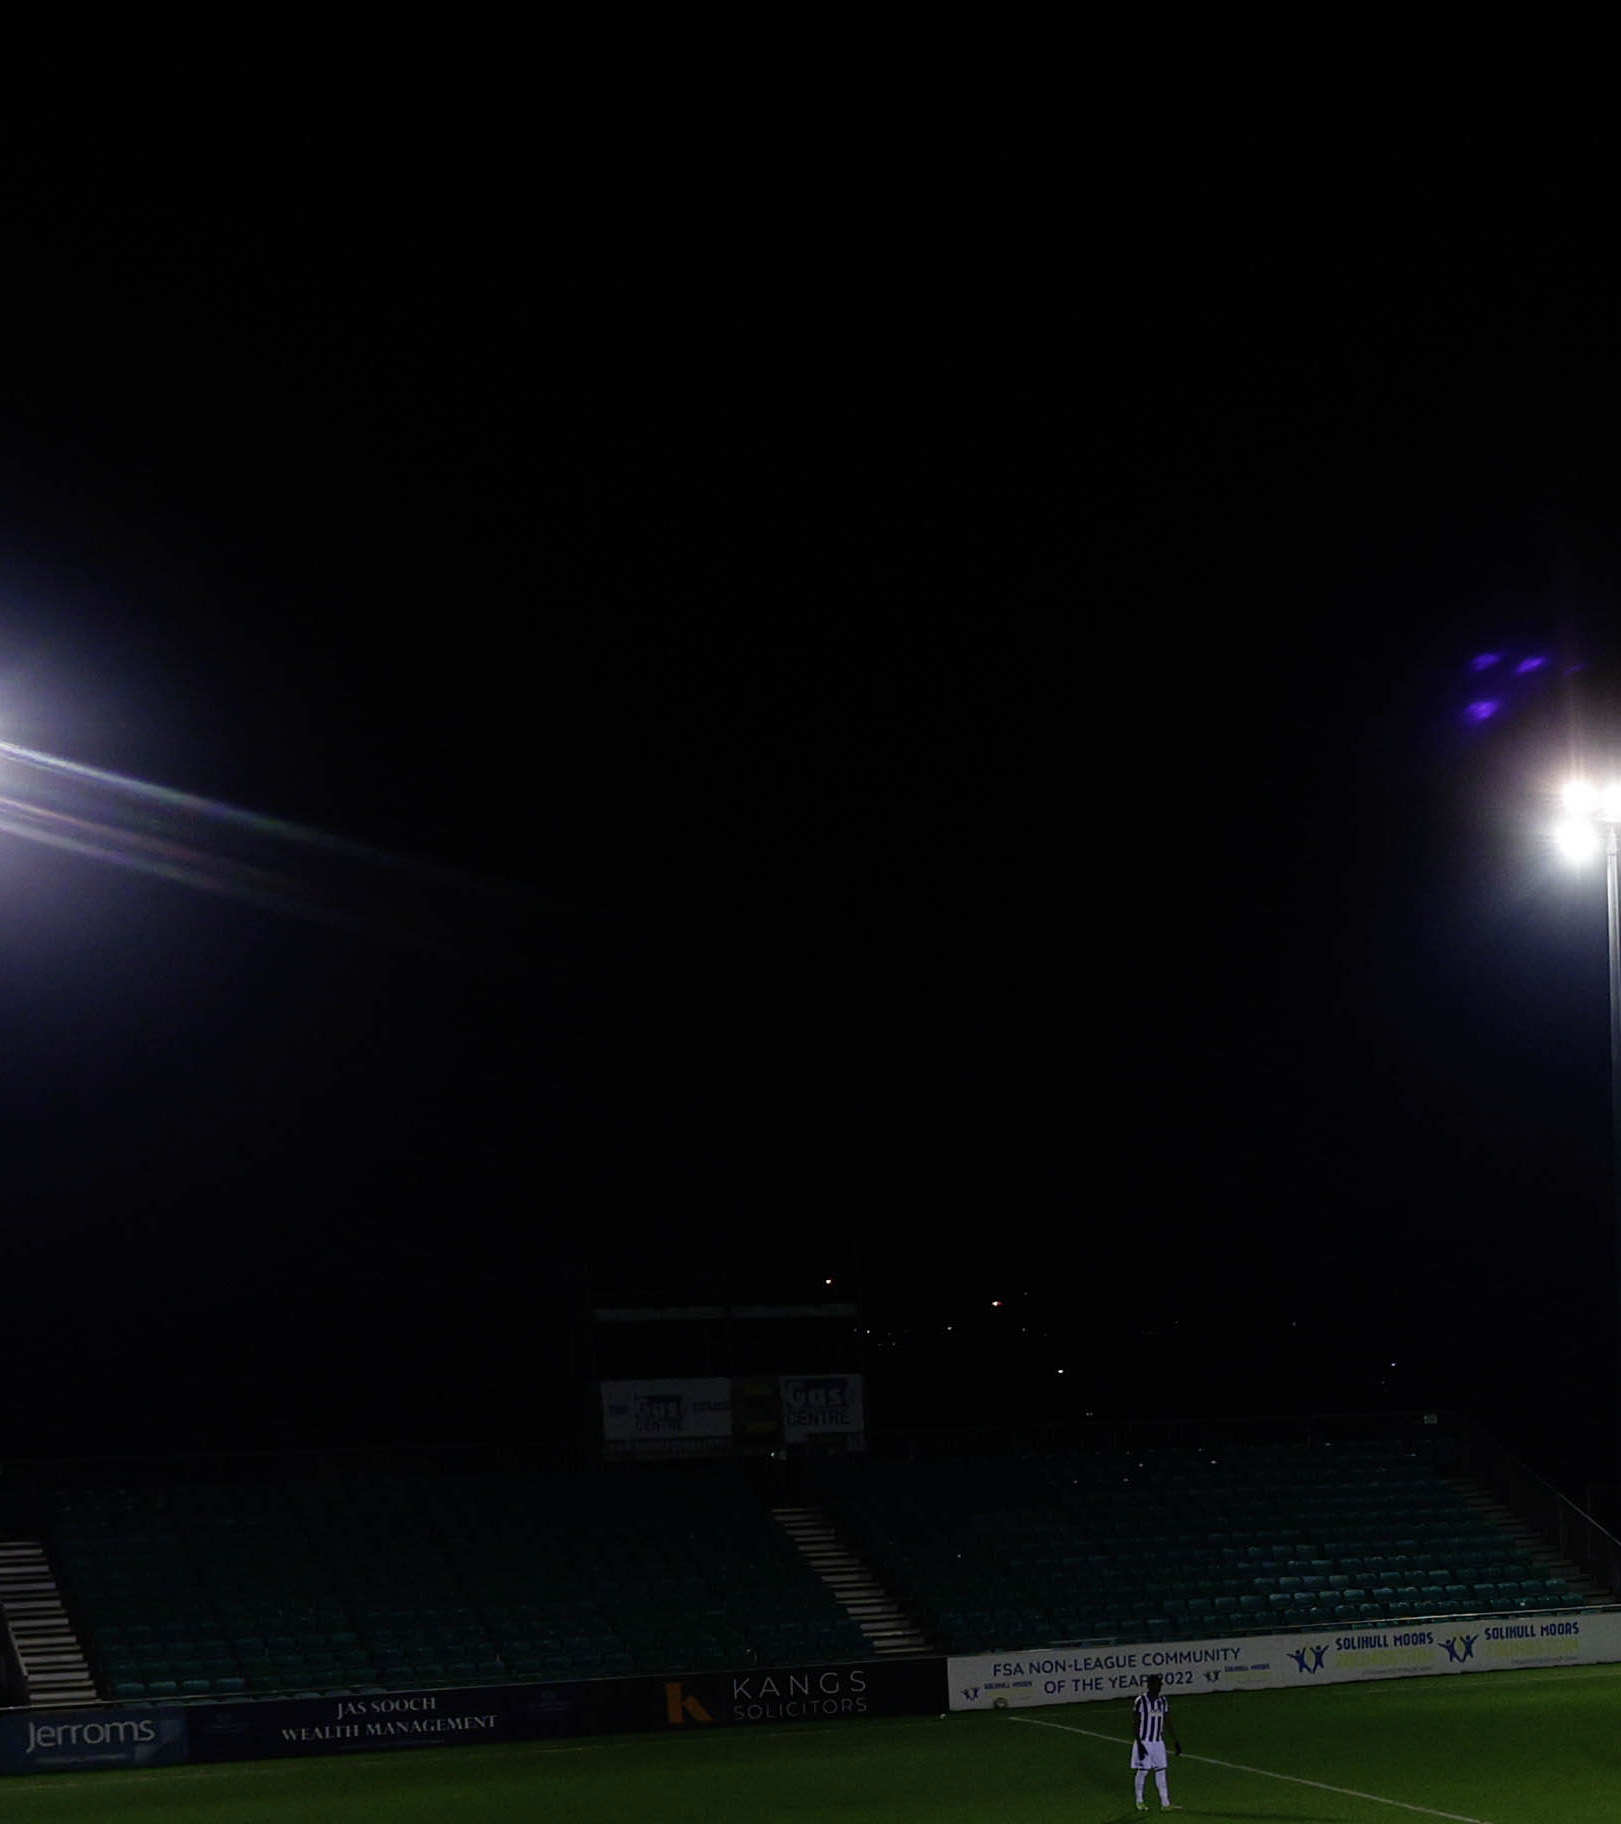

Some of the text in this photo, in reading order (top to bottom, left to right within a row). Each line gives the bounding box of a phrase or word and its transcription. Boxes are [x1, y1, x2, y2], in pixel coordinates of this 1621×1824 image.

[1335, 1631, 1434, 1651] SOLIHULL MOORS
[1484, 1622, 1580, 1641] SOLIHULL MOORS
[993, 1647, 1241, 1677] FSA NON-LEAGUE COMMUNITY
[733, 1670, 868, 1701] KANGS
[1044, 1681, 1066, 1695] OF
[1070, 1677, 1103, 1692] THE
[336, 1696, 437, 1721] JAS SOOCH
[733, 1697, 869, 1721] SOLICITORS
[25, 1719, 157, 1752] Jerroms
[280, 1713, 498, 1742] WEALTH MANAGEMENT
